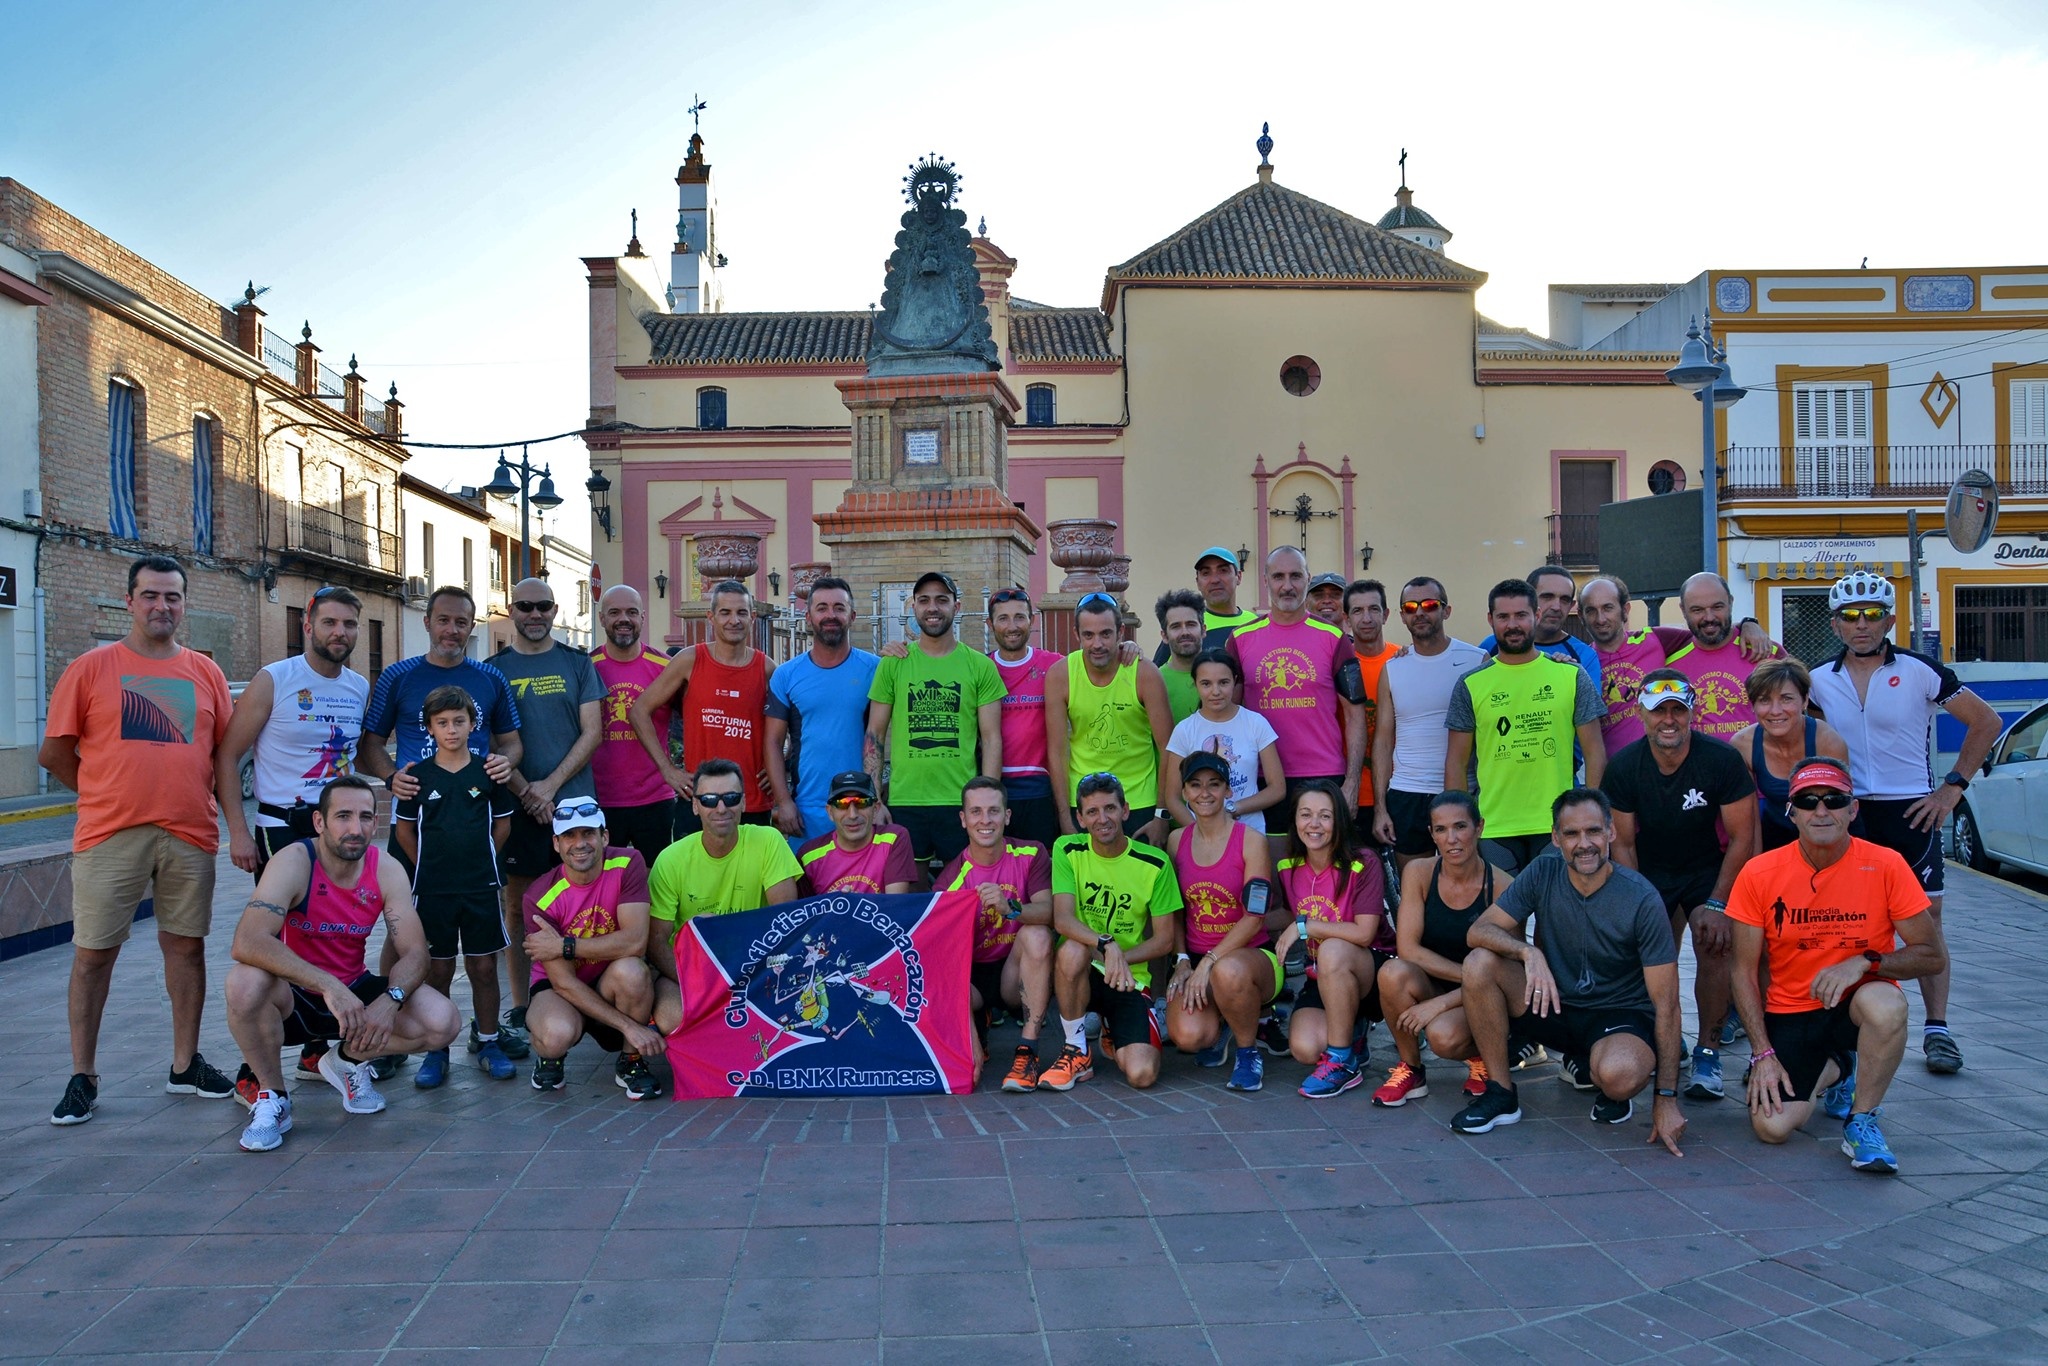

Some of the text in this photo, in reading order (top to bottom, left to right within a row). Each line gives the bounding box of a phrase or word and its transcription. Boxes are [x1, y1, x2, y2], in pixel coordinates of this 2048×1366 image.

[1802, 550, 1857, 562] Alberto
[1260, 648, 1292, 666] ATLETISMO
[1002, 696, 1018, 704] NK
[1271, 698, 1284, 708] BNK
[1286, 697, 1316, 708] RUNNERS
[702, 714, 752, 728] NOCTURNA
[1516, 710, 1552, 720] RENAULT
[724, 726, 752, 740] 2012
[696, 896, 720, 908] CARRER
[1790, 907, 1840, 924] III media
[1810, 911, 1866, 922] maratón
[290, 918, 314, 932] C.D.
[320, 923, 346, 933] BNK
[724, 896, 928, 1028] Club Atletismo Benacazón
[727, 1066, 936, 1089] C.D. BNK Runners
